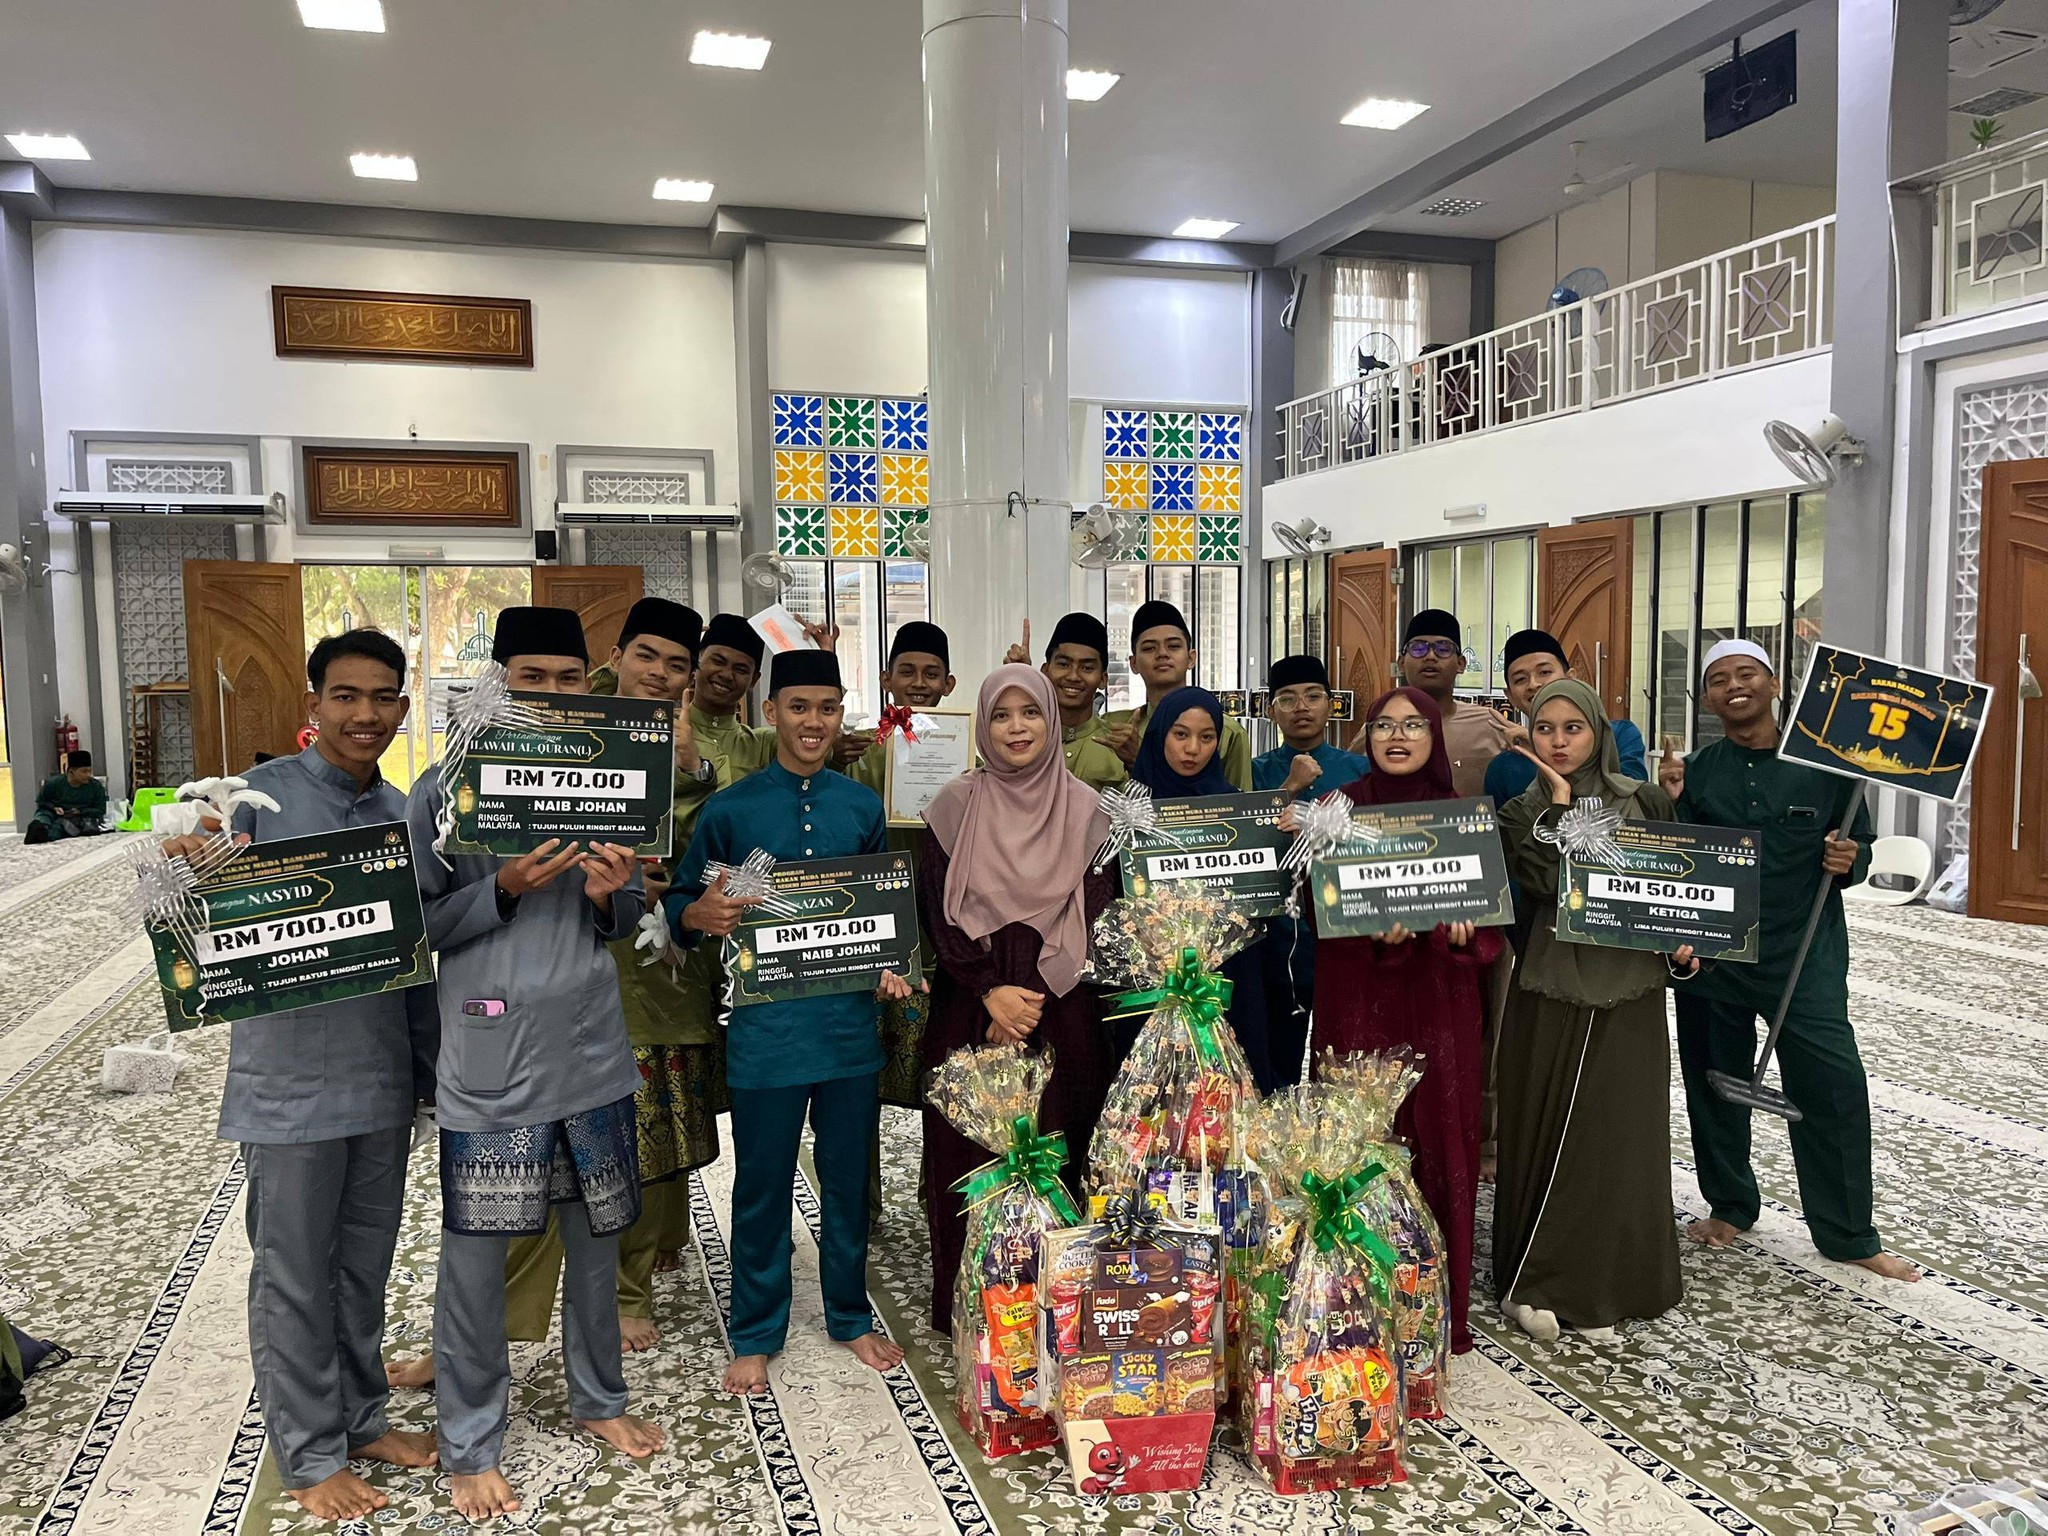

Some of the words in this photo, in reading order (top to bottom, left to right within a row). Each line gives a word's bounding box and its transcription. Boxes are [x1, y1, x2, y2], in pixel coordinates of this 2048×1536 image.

[1868, 702, 1910, 740] 15
[469, 741, 514, 752] ILAWAH
[518, 743, 592, 757] AL-QURAN(L)
[506, 769, 544, 787] RM
[551, 770, 625, 790] 70.00
[478, 801, 505, 809] NAMA
[534, 801, 571, 812] NAIB
[575, 801, 627, 813] JOHAN
[478, 814, 514, 822] RINGGIT
[478, 821, 521, 830] MALAYSIA
[1160, 858, 1190, 872] RM
[1194, 851, 1265, 869] 100.00
[1358, 865, 1391, 880] RM
[1396, 859, 1462, 877] 70.00
[248, 884, 313, 907] NASYID
[1386, 886, 1418, 898] NAIB
[1422, 882, 1468, 895] JOHAN
[1607, 878, 1641, 894] RM
[1646, 882, 1715, 902] 50.00
[1585, 911, 1616, 920] RINGGIT
[1586, 901, 1608, 910] NAMA
[1649, 906, 1700, 921] KETIGA
[213, 927, 260, 952] RM
[267, 907, 377, 942] 700.00
[1585, 918, 1622, 927] MALAYSIA
[775, 926, 808, 944] RM
[813, 919, 877, 939] 70.00
[757, 956, 779, 965] NAMA
[802, 948, 834, 961] NAIB
[837, 943, 881, 958] JOHAN
[200, 967, 231, 979] NAMA
[267, 947, 330, 968] JOHAN
[757, 966, 787, 976] RINGGIT
[758, 972, 794, 982] MALAYSIA
[803, 969, 824, 977] TUJUH
[875, 960, 900, 968] SAHAJA
[267, 976, 298, 988] TUJUH
[300, 972, 329, 982] RATUS
[367, 957, 401, 969] SAHAJA
[1185, 1260, 1213, 1273] CASTLE
[1096, 1296, 1116, 1306] fudo
[1093, 1309, 1140, 1324] SWISS
[1122, 1353, 1155, 1365] LUCKY
[1118, 1363, 1157, 1378] STAR
[1141, 1443, 1183, 1460] Wishing
[1184, 1442, 1204, 1455] You
[1145, 1459, 1170, 1472] All
[1168, 1460, 1182, 1470] the
[1182, 1457, 1201, 1469] best
